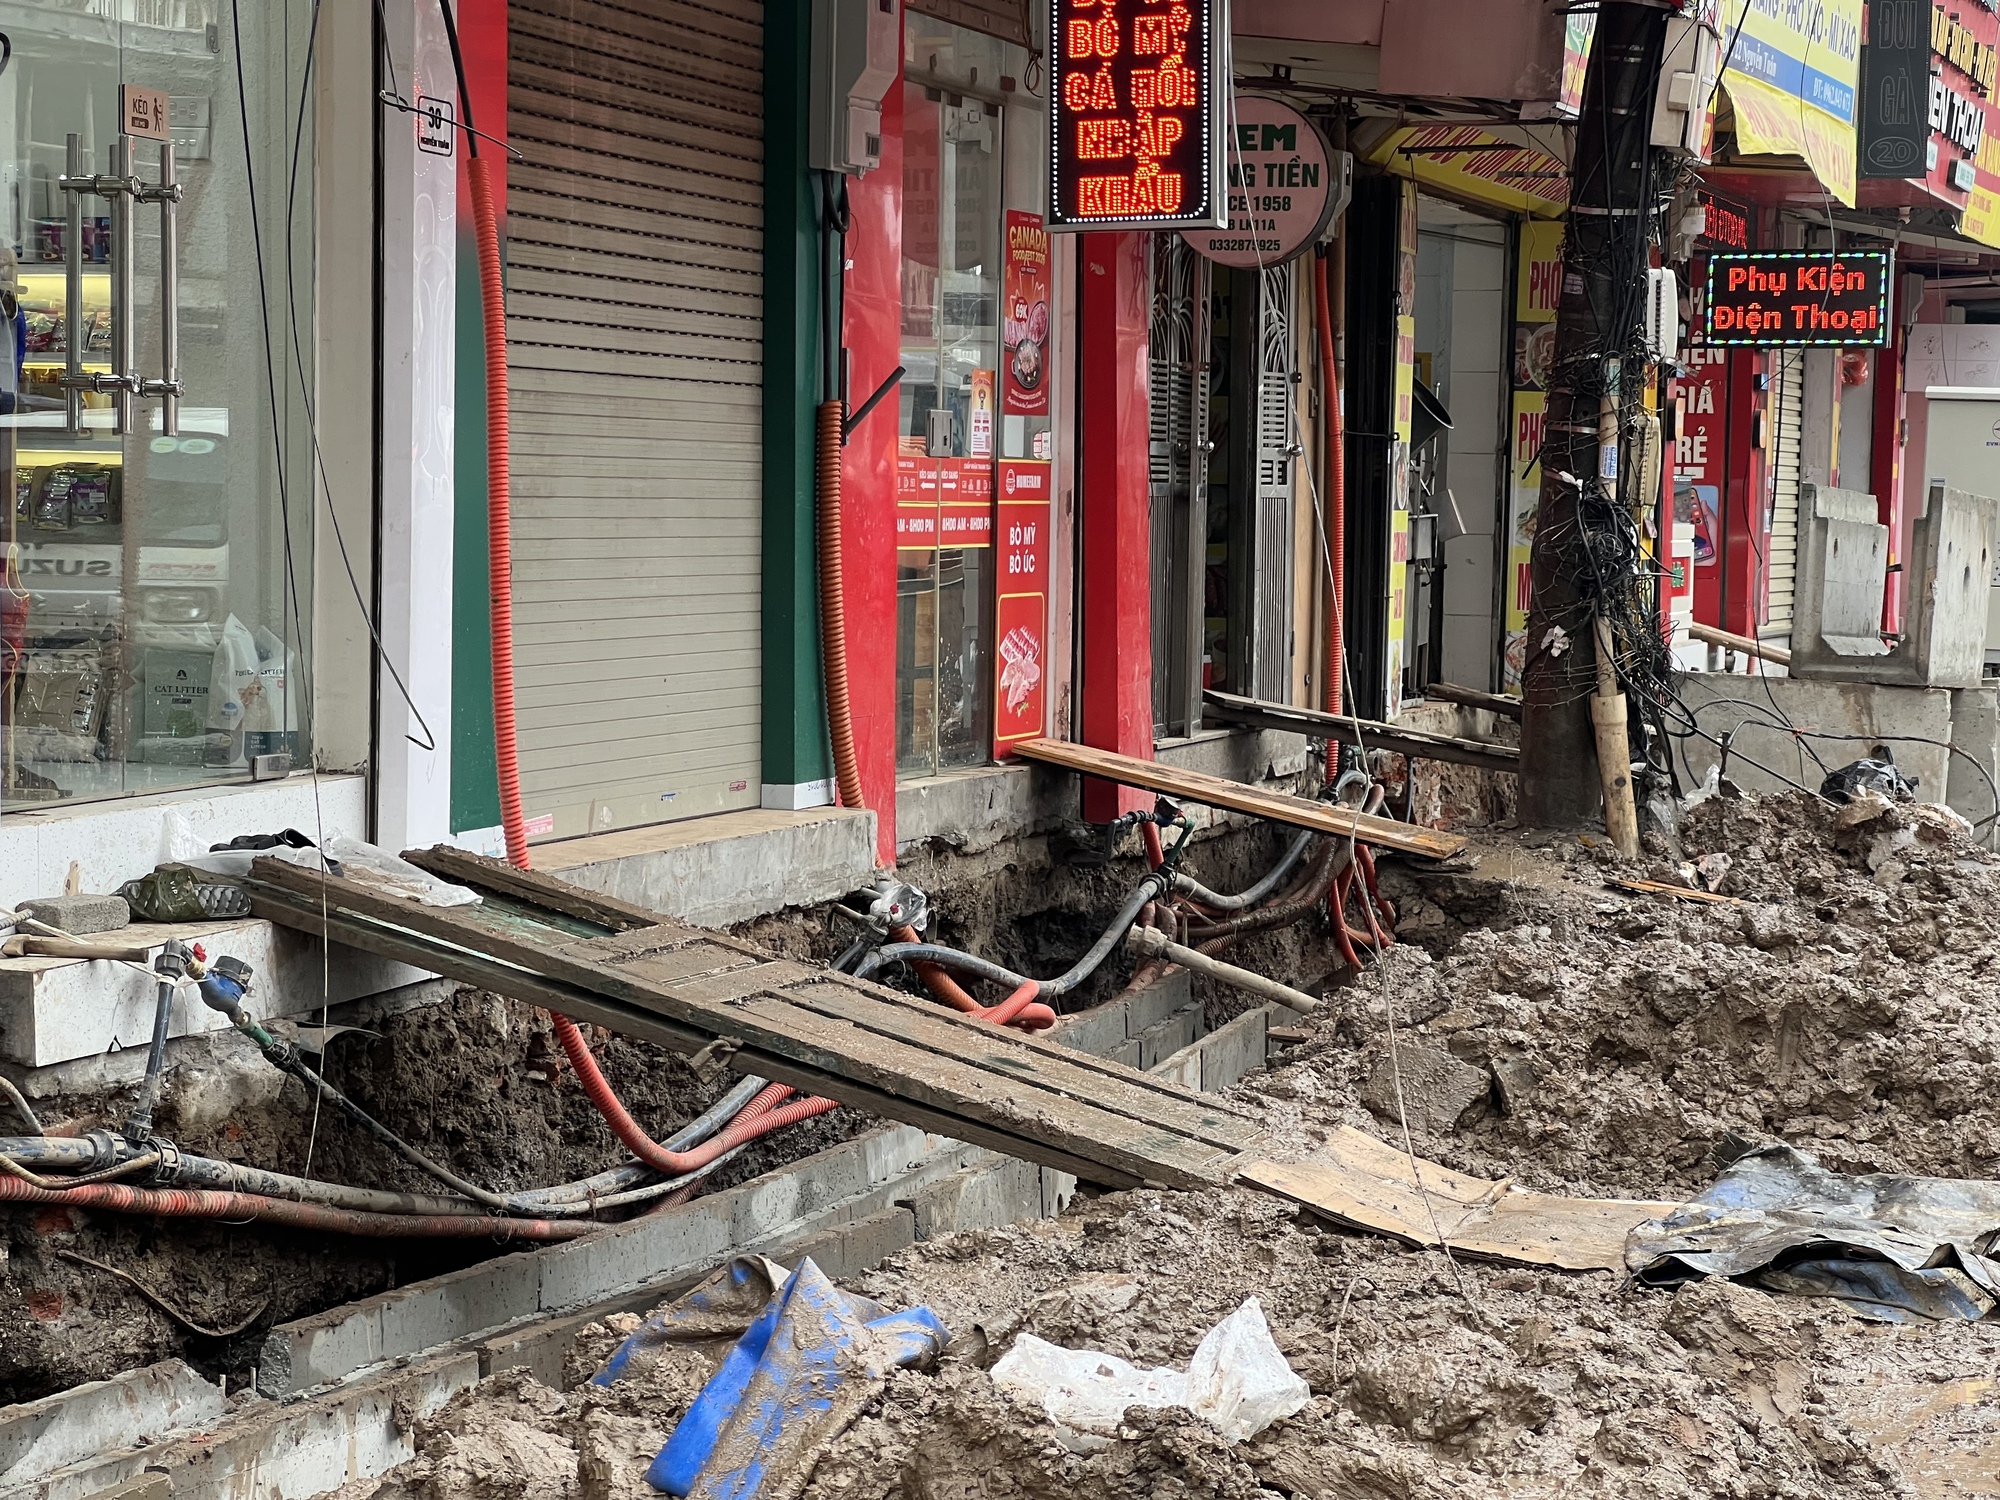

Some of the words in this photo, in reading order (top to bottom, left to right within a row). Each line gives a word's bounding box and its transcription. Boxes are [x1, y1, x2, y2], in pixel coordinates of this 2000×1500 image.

[1065, 61, 1117, 110] CÁ
[132, 95, 148, 115] KÉO
[1877, 142, 1911, 162] 20
[1228, 163, 1256, 187] NG
[1264, 155, 1319, 187] TIỀN
[1228, 197, 1250, 211] CE
[1253, 196, 1292, 211] 1958
[1009, 226, 1048, 254] CANADA
[1209, 239, 1281, 251] 0332875925
[1729, 266, 1787, 296] Phụ
[1797, 263, 1865, 296] Kiện
[1714, 303, 1782, 334] Điện
[1791, 304, 1877, 334] Thoại
[1675, 426, 1708, 464] RẺ
[1010, 521, 1022, 546] BÒ
[1023, 522, 1036, 545] MỸ
[1009, 549, 1021, 573] BÒ
[1023, 549, 1036, 573] ÚC
[155, 685, 172, 694] CAT
[175, 685, 208, 695] LITTER
